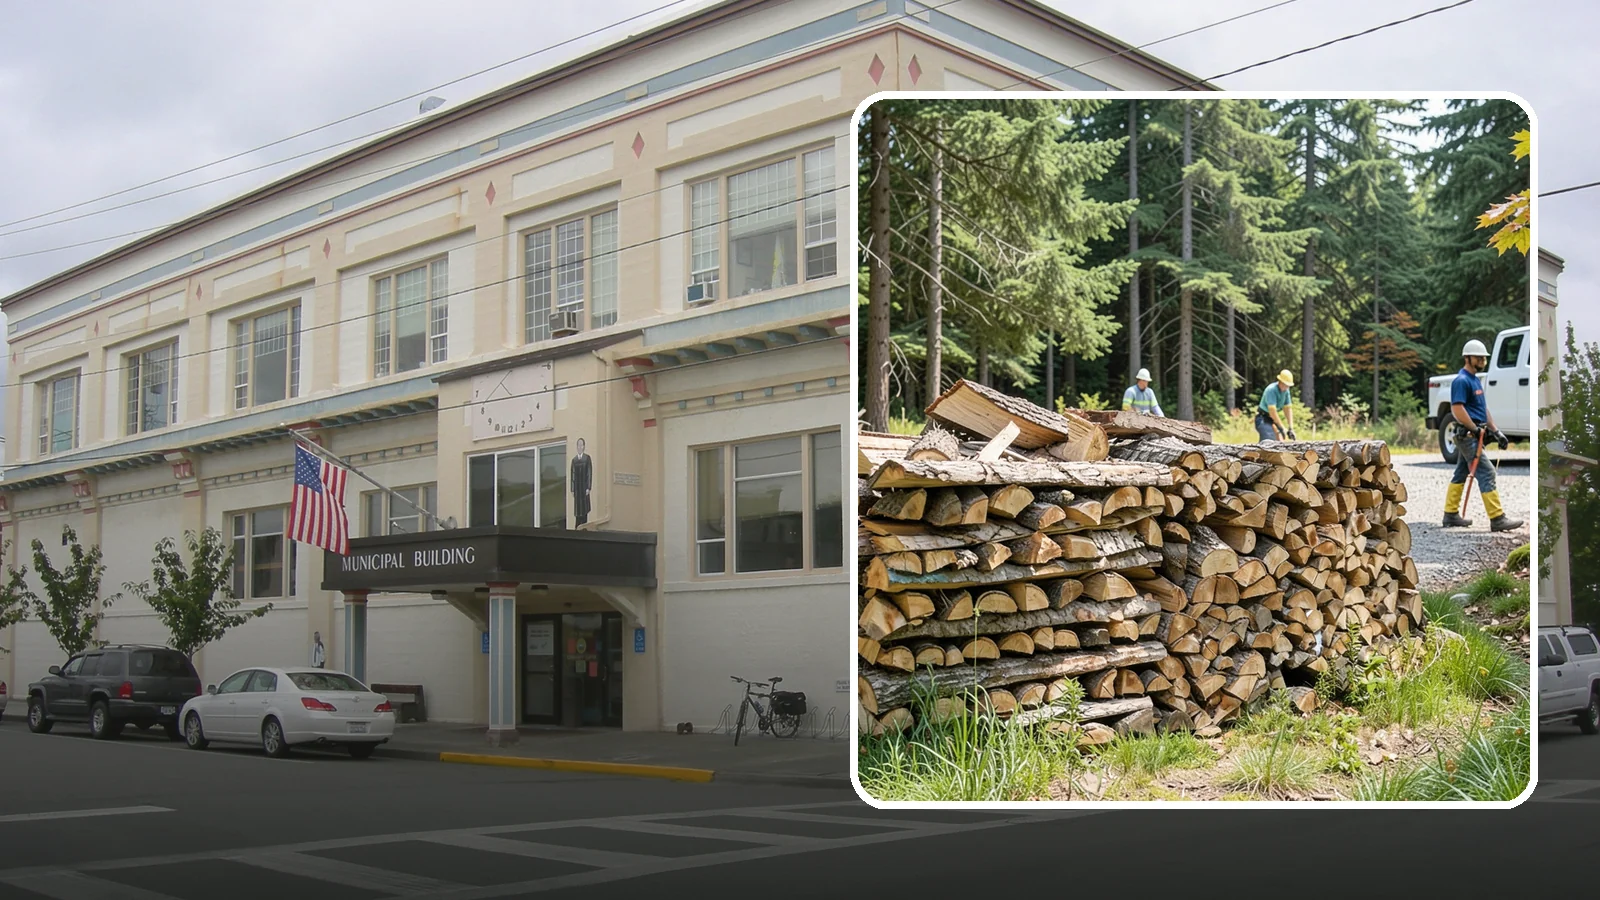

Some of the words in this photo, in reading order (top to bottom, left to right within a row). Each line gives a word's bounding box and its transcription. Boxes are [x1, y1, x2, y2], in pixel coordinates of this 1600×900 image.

[529, 414, 532, 422] 3
[342, 552, 405, 572] MUNICIPAL
[414, 546, 475, 567] BUILDING
